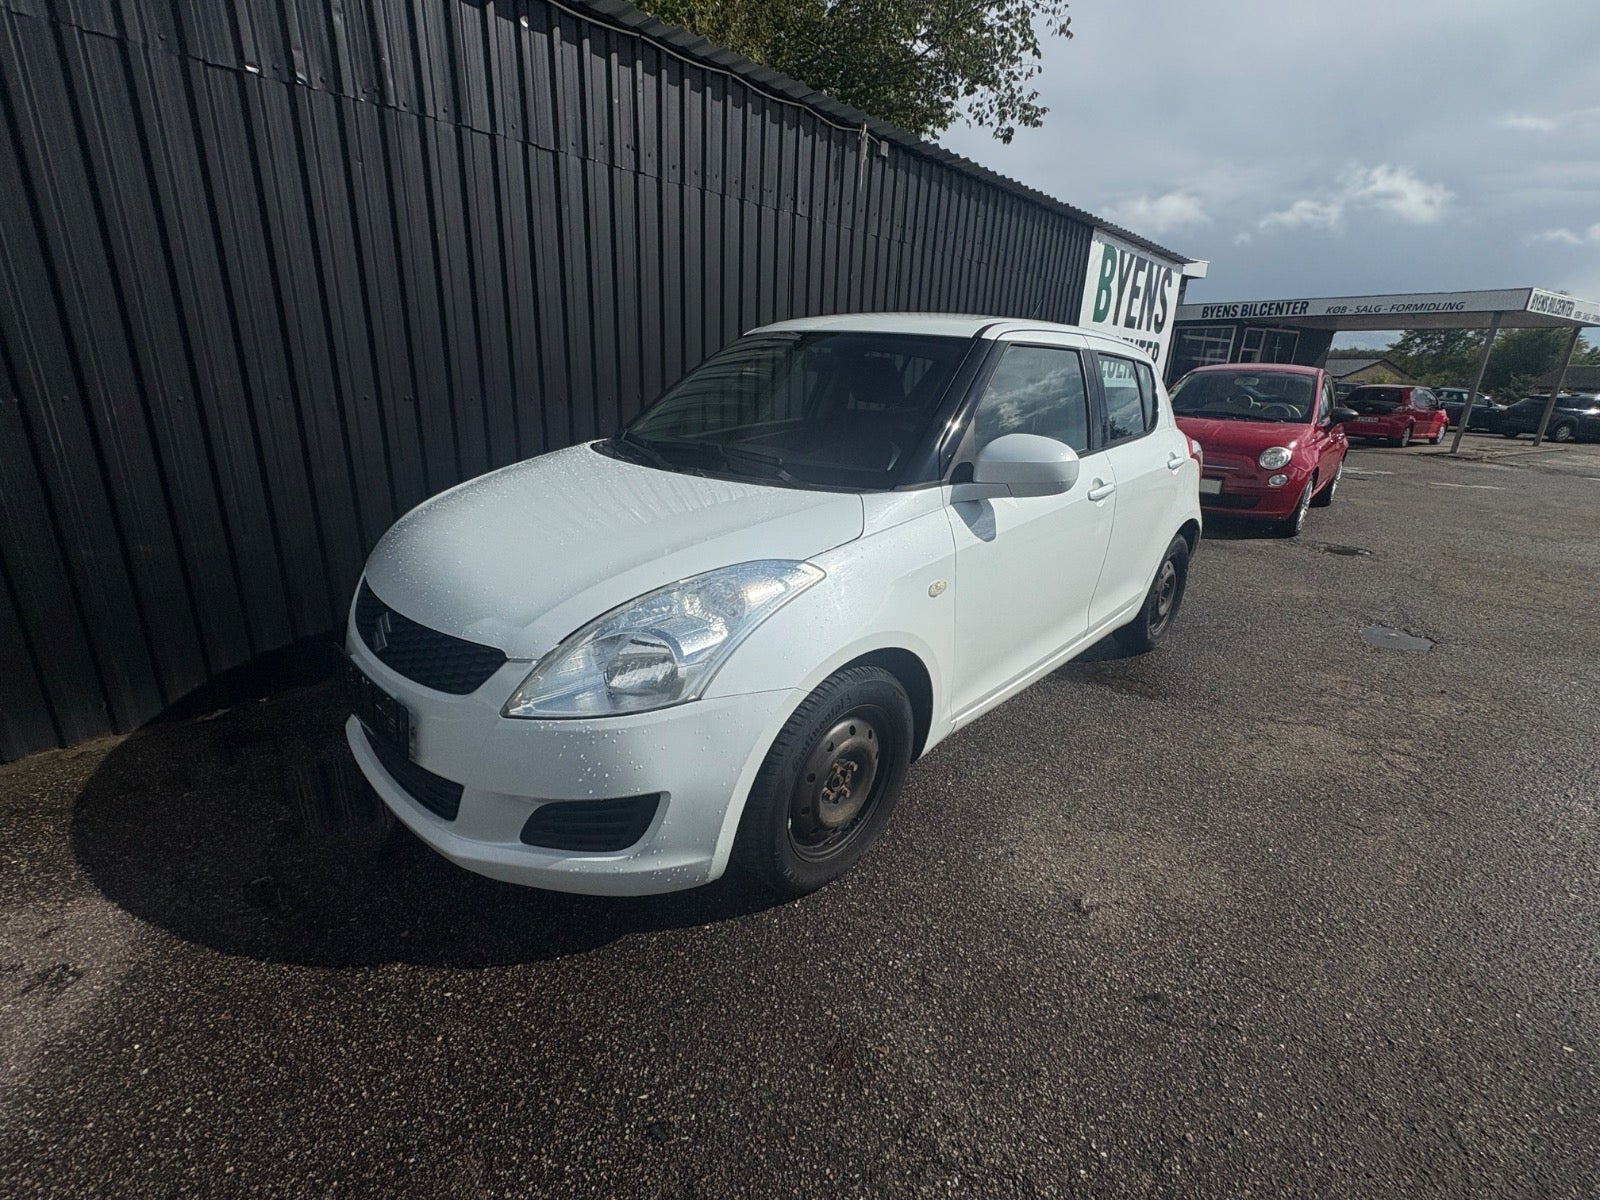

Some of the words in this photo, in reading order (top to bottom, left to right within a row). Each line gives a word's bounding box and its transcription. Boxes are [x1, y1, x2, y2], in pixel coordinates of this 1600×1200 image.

[1092, 243, 1173, 335] BYENS
[1201, 304, 1239, 318] BYENS
[1240, 301, 1309, 317] BILCENTER
[1325, 305, 1348, 314] KØB
[1354, 304, 1383, 314] SALG
[1389, 301, 1466, 313] FORMIDLING
